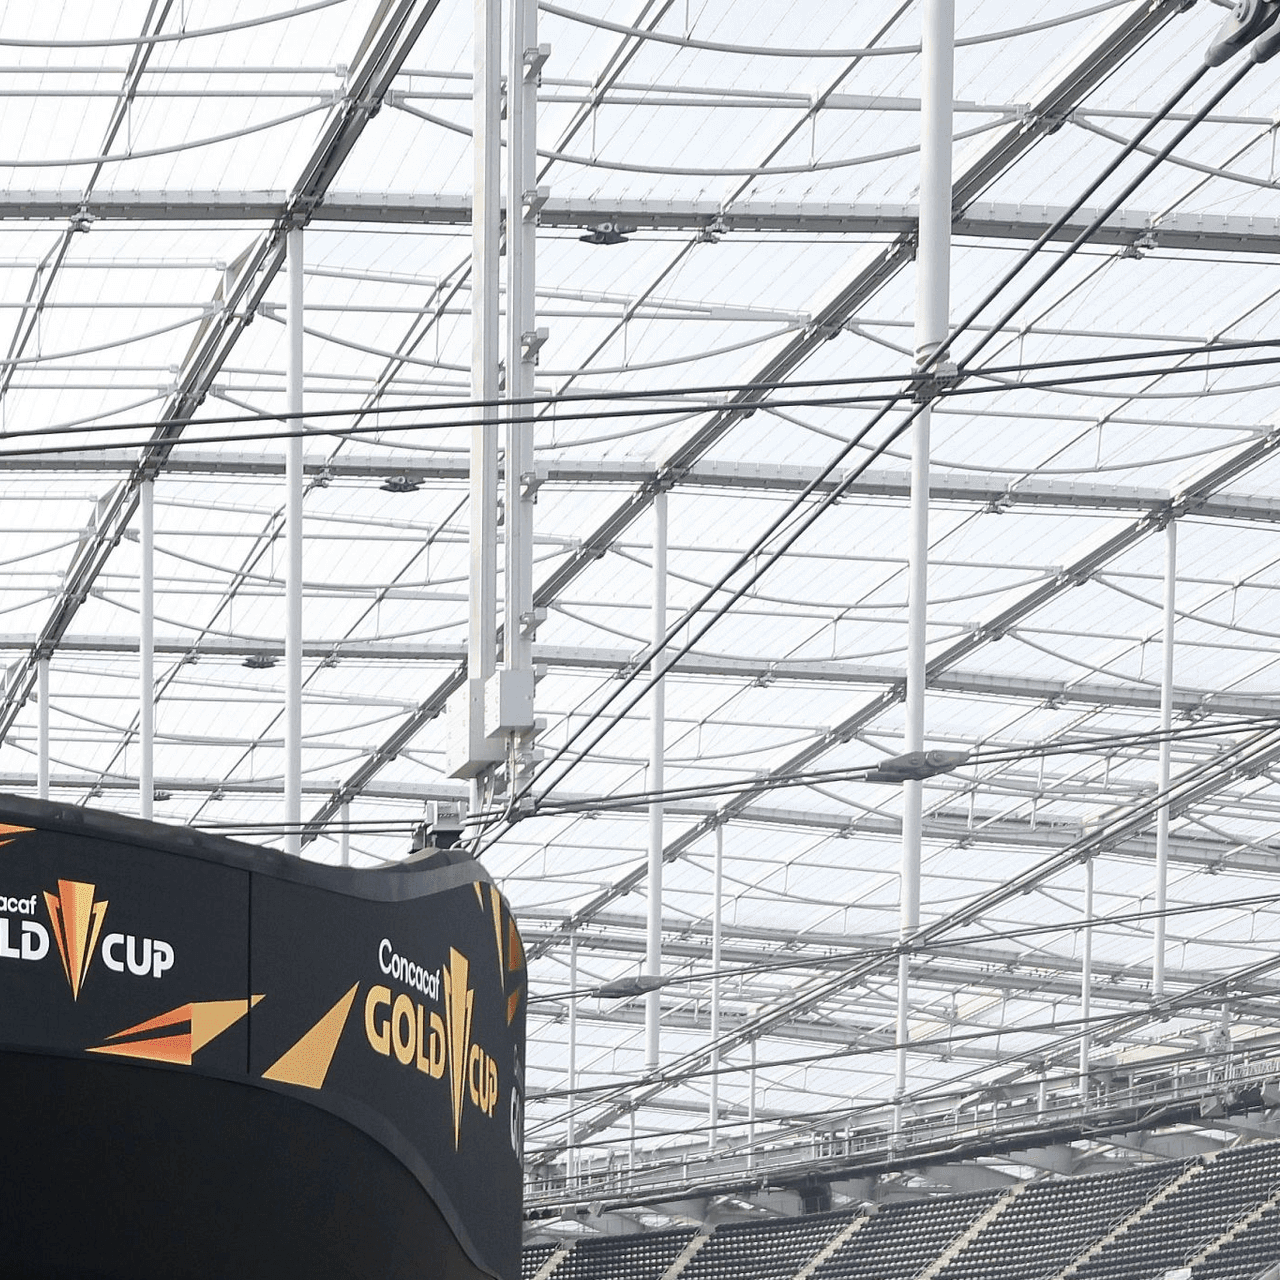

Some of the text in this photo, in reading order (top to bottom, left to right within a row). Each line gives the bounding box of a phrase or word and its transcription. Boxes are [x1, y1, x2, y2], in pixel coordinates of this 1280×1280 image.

[101, 932, 175, 979] CUP
[378, 938, 440, 1002] Concacaf
[364, 985, 446, 1079] GOLD
[469, 1043, 498, 1118] CUP
